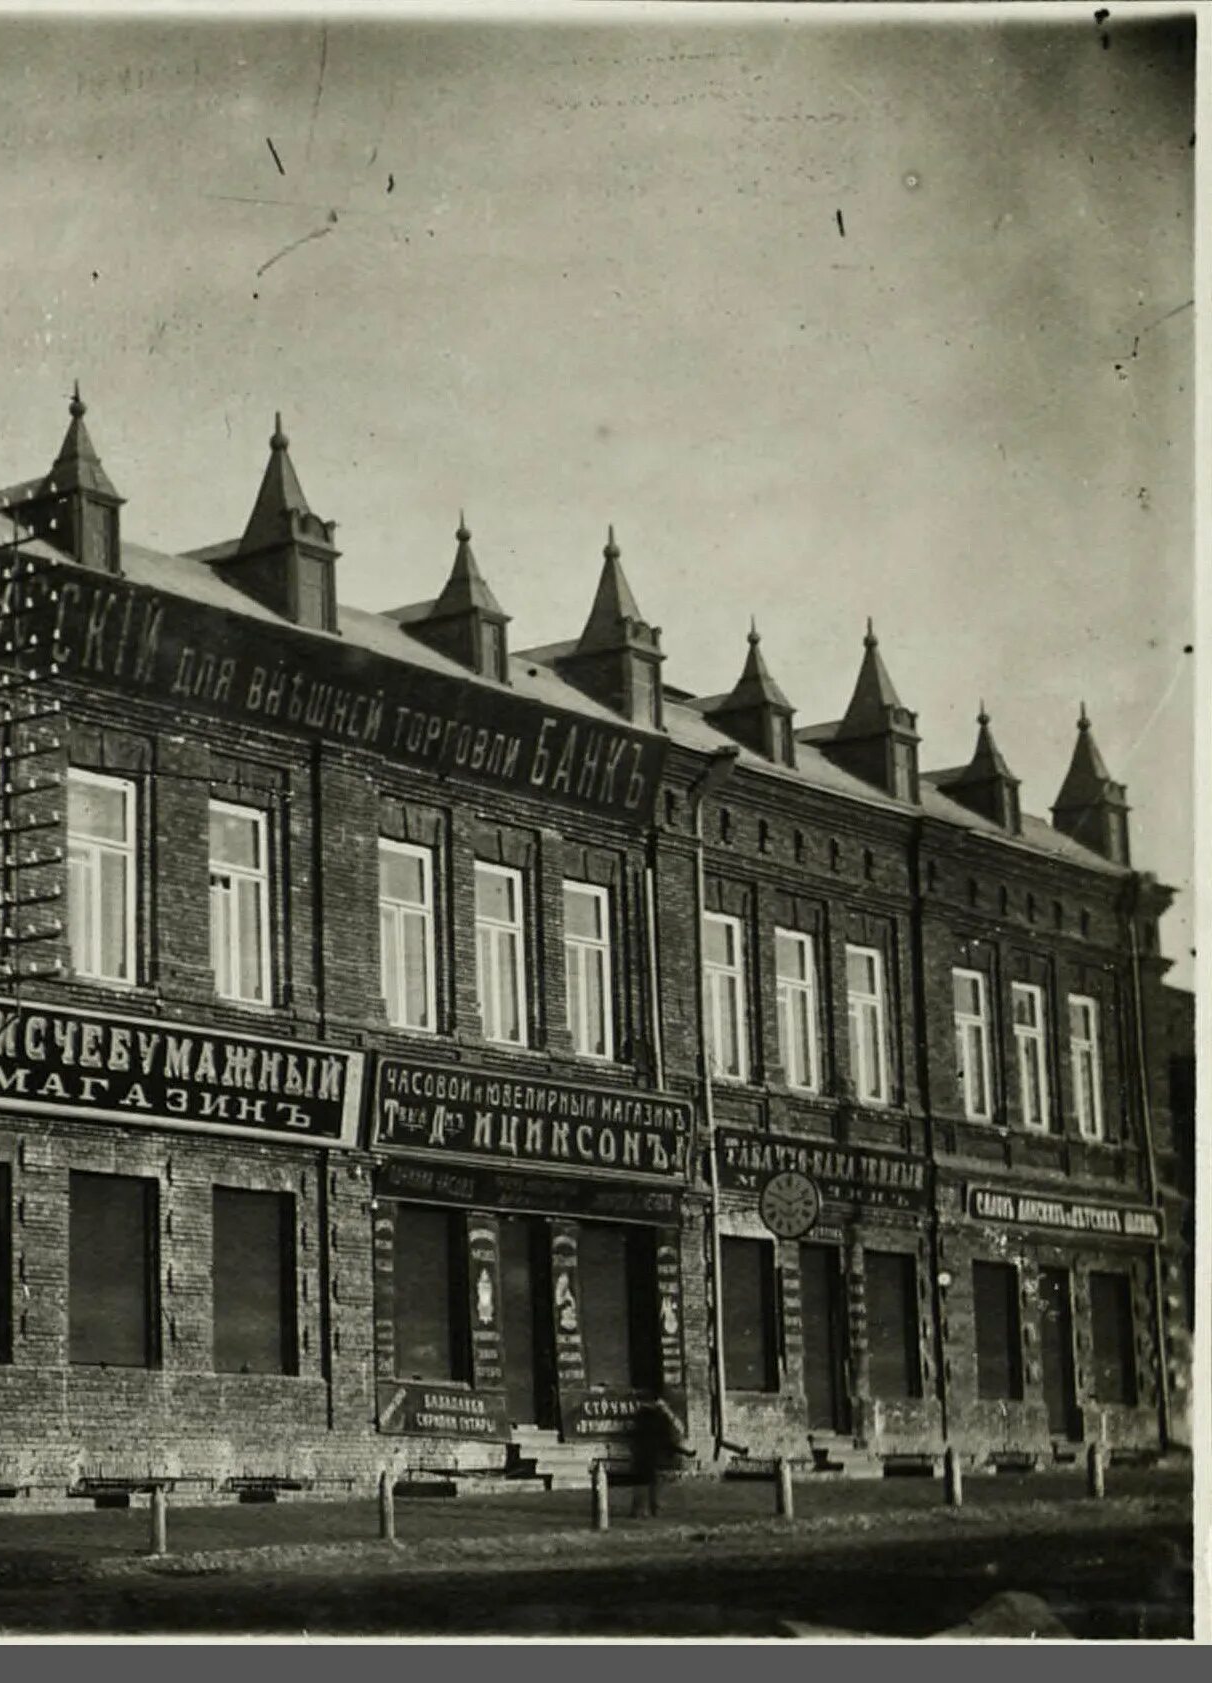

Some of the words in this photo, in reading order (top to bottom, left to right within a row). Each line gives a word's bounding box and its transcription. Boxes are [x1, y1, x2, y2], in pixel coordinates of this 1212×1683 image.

[172, 646, 237, 701] ДЛЯ
[245, 666, 385, 743] ВНѢШНЕЙ
[391, 705, 523, 781] ТОРГОВЛИ
[529, 716, 648, 810] БАНКЪ
[386, 1066, 471, 1102] ЧАСОВОЙ
[488, 1082, 596, 1119] ЮВЕЛИРНЫЙ
[600, 1097, 687, 1132] МАГАЗИНЪ
